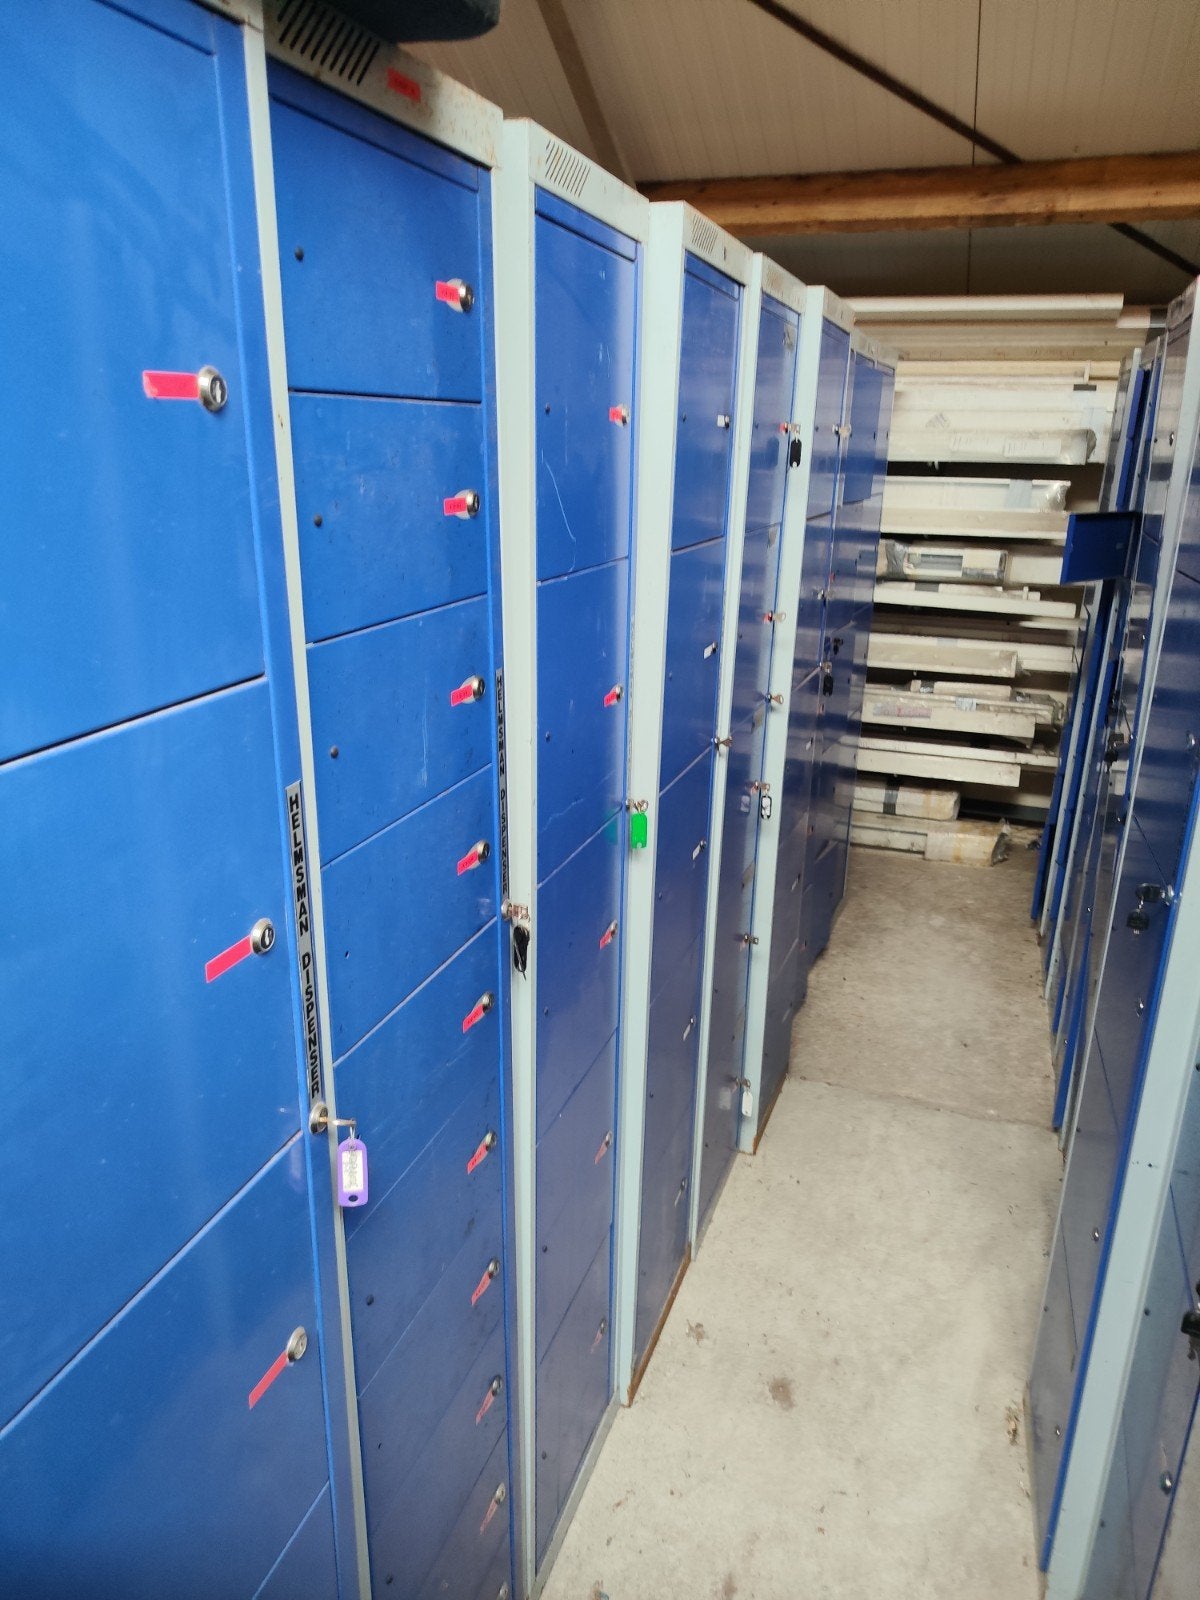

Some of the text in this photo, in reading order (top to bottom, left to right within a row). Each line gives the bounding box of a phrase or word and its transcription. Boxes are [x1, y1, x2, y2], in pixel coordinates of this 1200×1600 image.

[496, 674, 508, 895] HELMSMAN DISPENSER
[289, 794, 320, 1099] HELMSMAN DISPENSER
